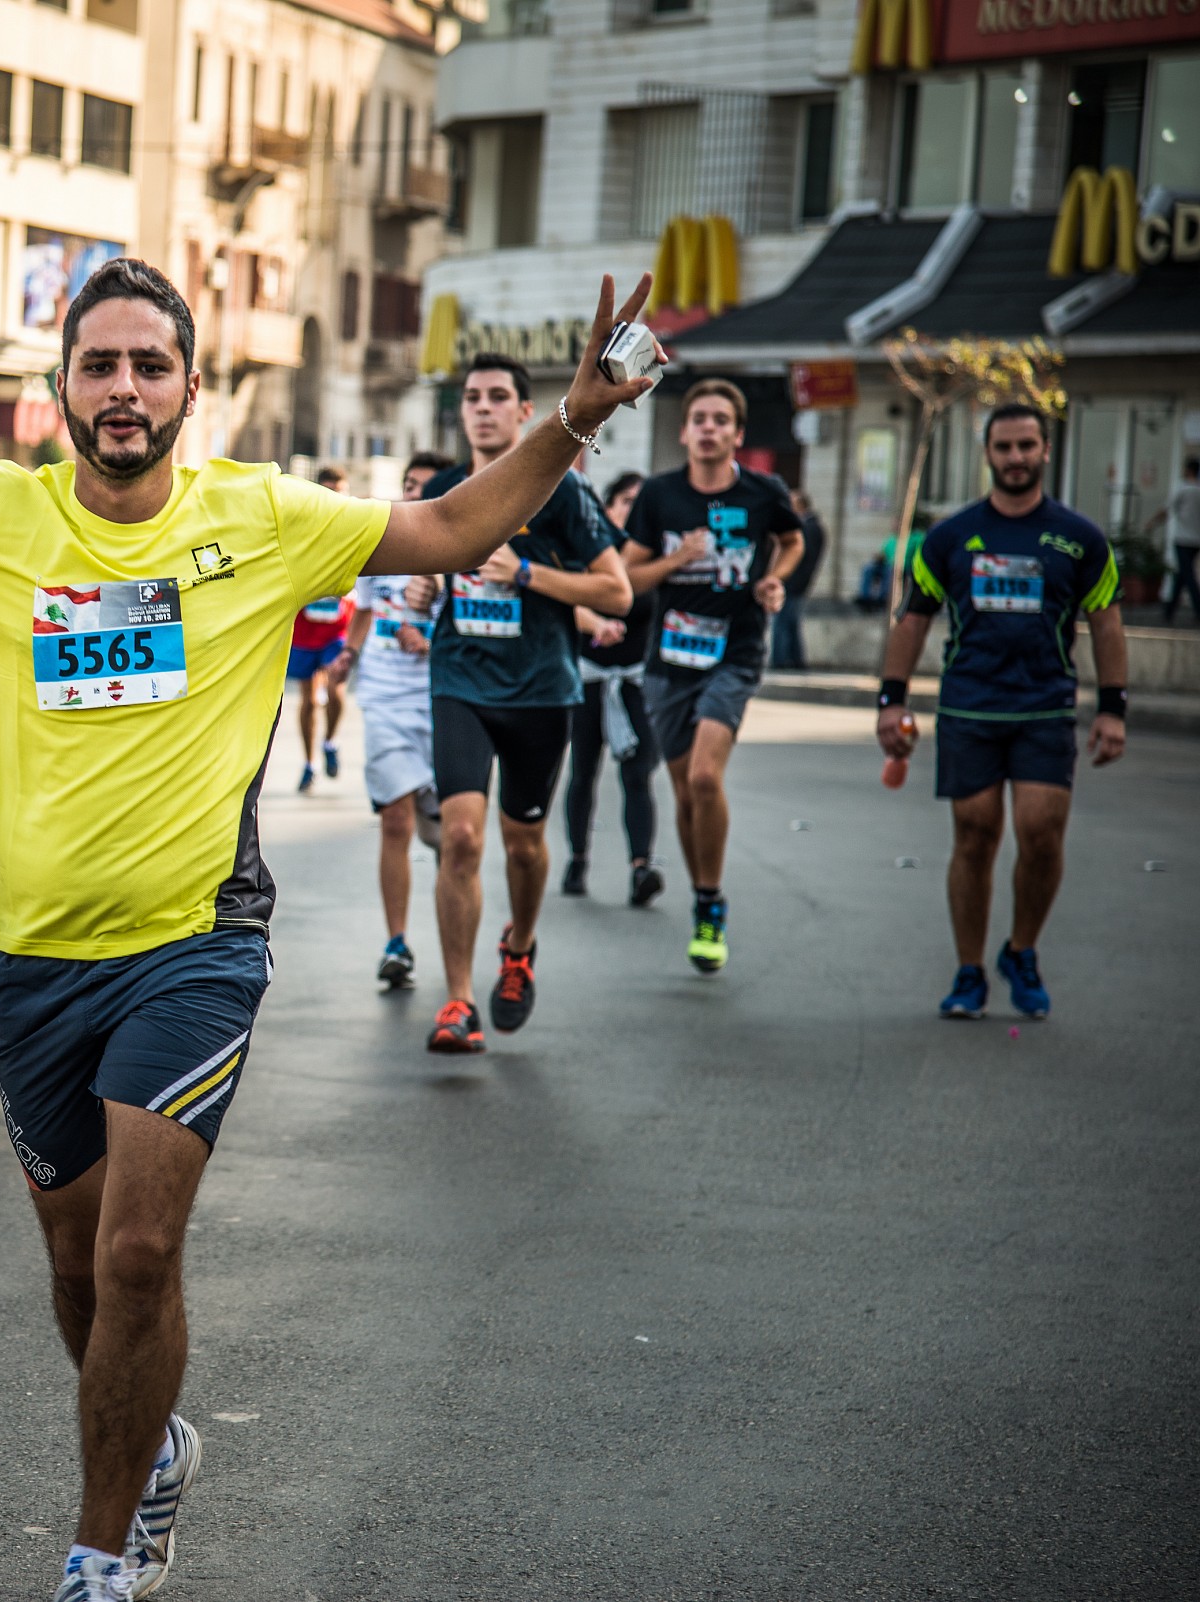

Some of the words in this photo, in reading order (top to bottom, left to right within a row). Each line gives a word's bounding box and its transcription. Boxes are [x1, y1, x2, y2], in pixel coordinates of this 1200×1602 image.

[977, 0, 1199, 35] McDonads
[129, 615, 142, 623] NOV
[155, 613, 171, 621] 2013
[461, 600, 513, 620] 12000
[58, 631, 154, 677] 5565
